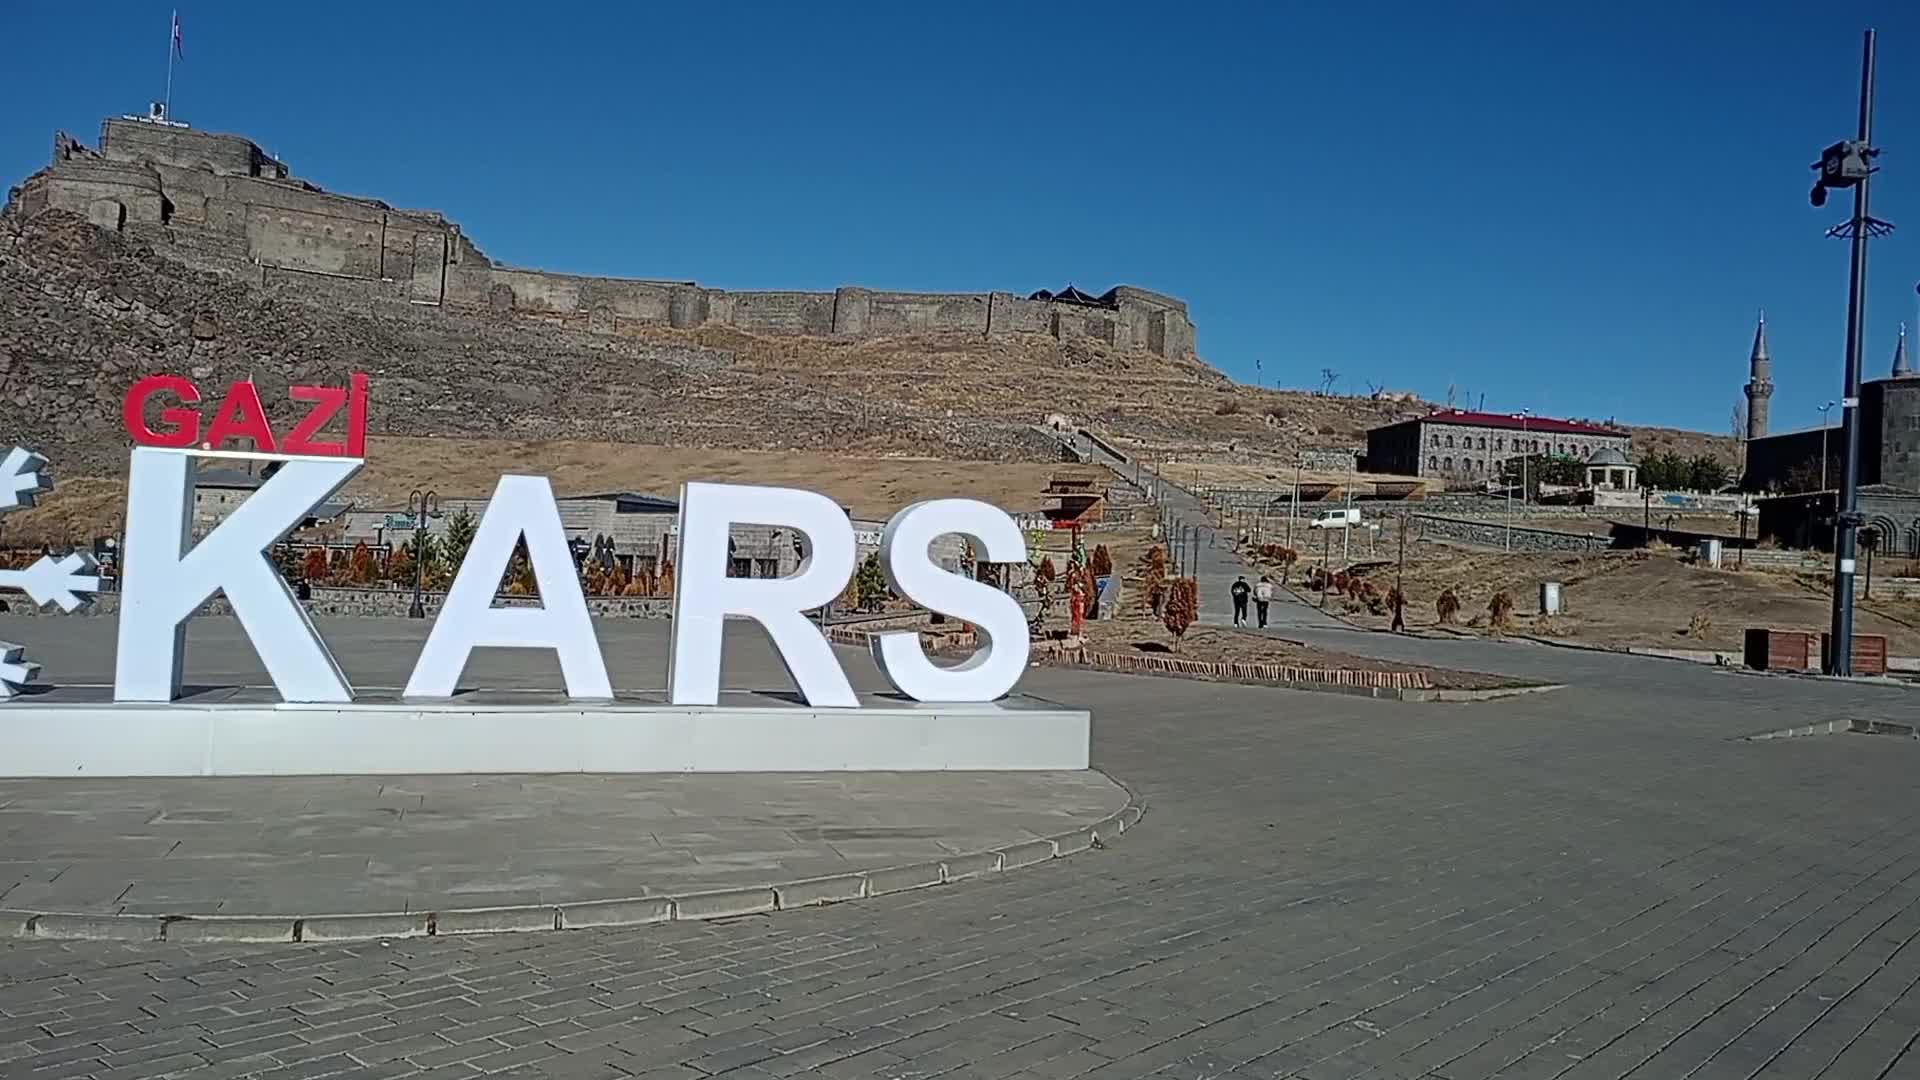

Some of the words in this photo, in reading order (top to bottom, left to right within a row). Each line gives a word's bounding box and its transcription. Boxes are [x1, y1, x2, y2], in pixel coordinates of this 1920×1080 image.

[122, 372, 368, 459] GAZİ
[1019, 519, 1053, 530] KARS
[114, 446, 1030, 707] KARS
